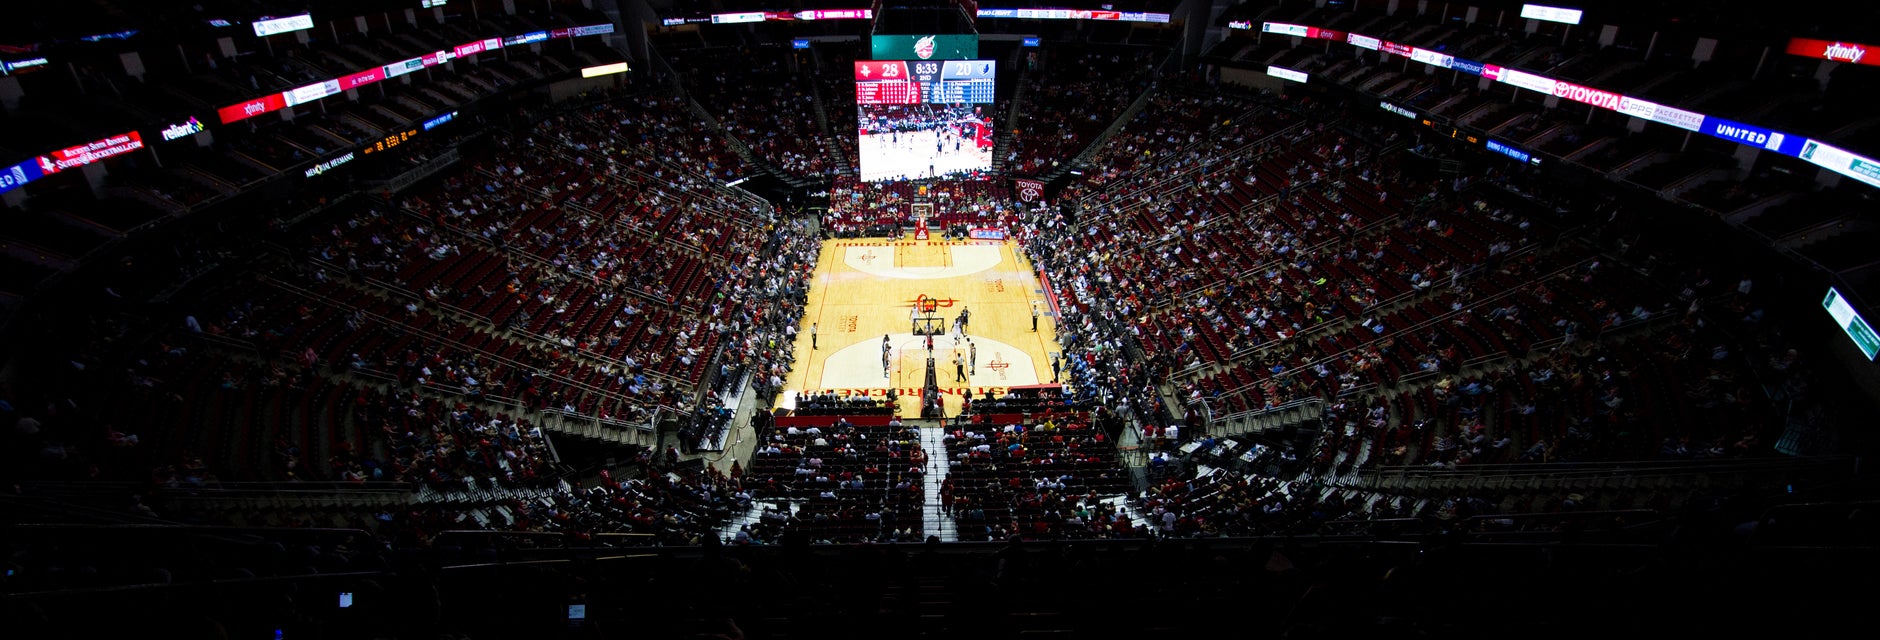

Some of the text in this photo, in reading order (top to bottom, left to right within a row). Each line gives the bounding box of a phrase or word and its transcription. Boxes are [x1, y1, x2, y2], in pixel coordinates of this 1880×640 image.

[1229, 20, 1246, 30] reliant
[1319, 29, 1334, 39] xfinity
[1823, 41, 1865, 63] xfinity
[882, 63, 899, 77] 28
[916, 63, 938, 74] 8:33
[956, 62, 972, 76] 20
[1569, 86, 1618, 110] TOYOTA
[244, 101, 265, 116] xfinity
[1629, 102, 1653, 117] PPS
[1654, 108, 1702, 124] PACESETTER
[162, 121, 195, 141] reliant
[1716, 124, 1766, 144] UNITED
[1017, 181, 1043, 190] TOYOTA
